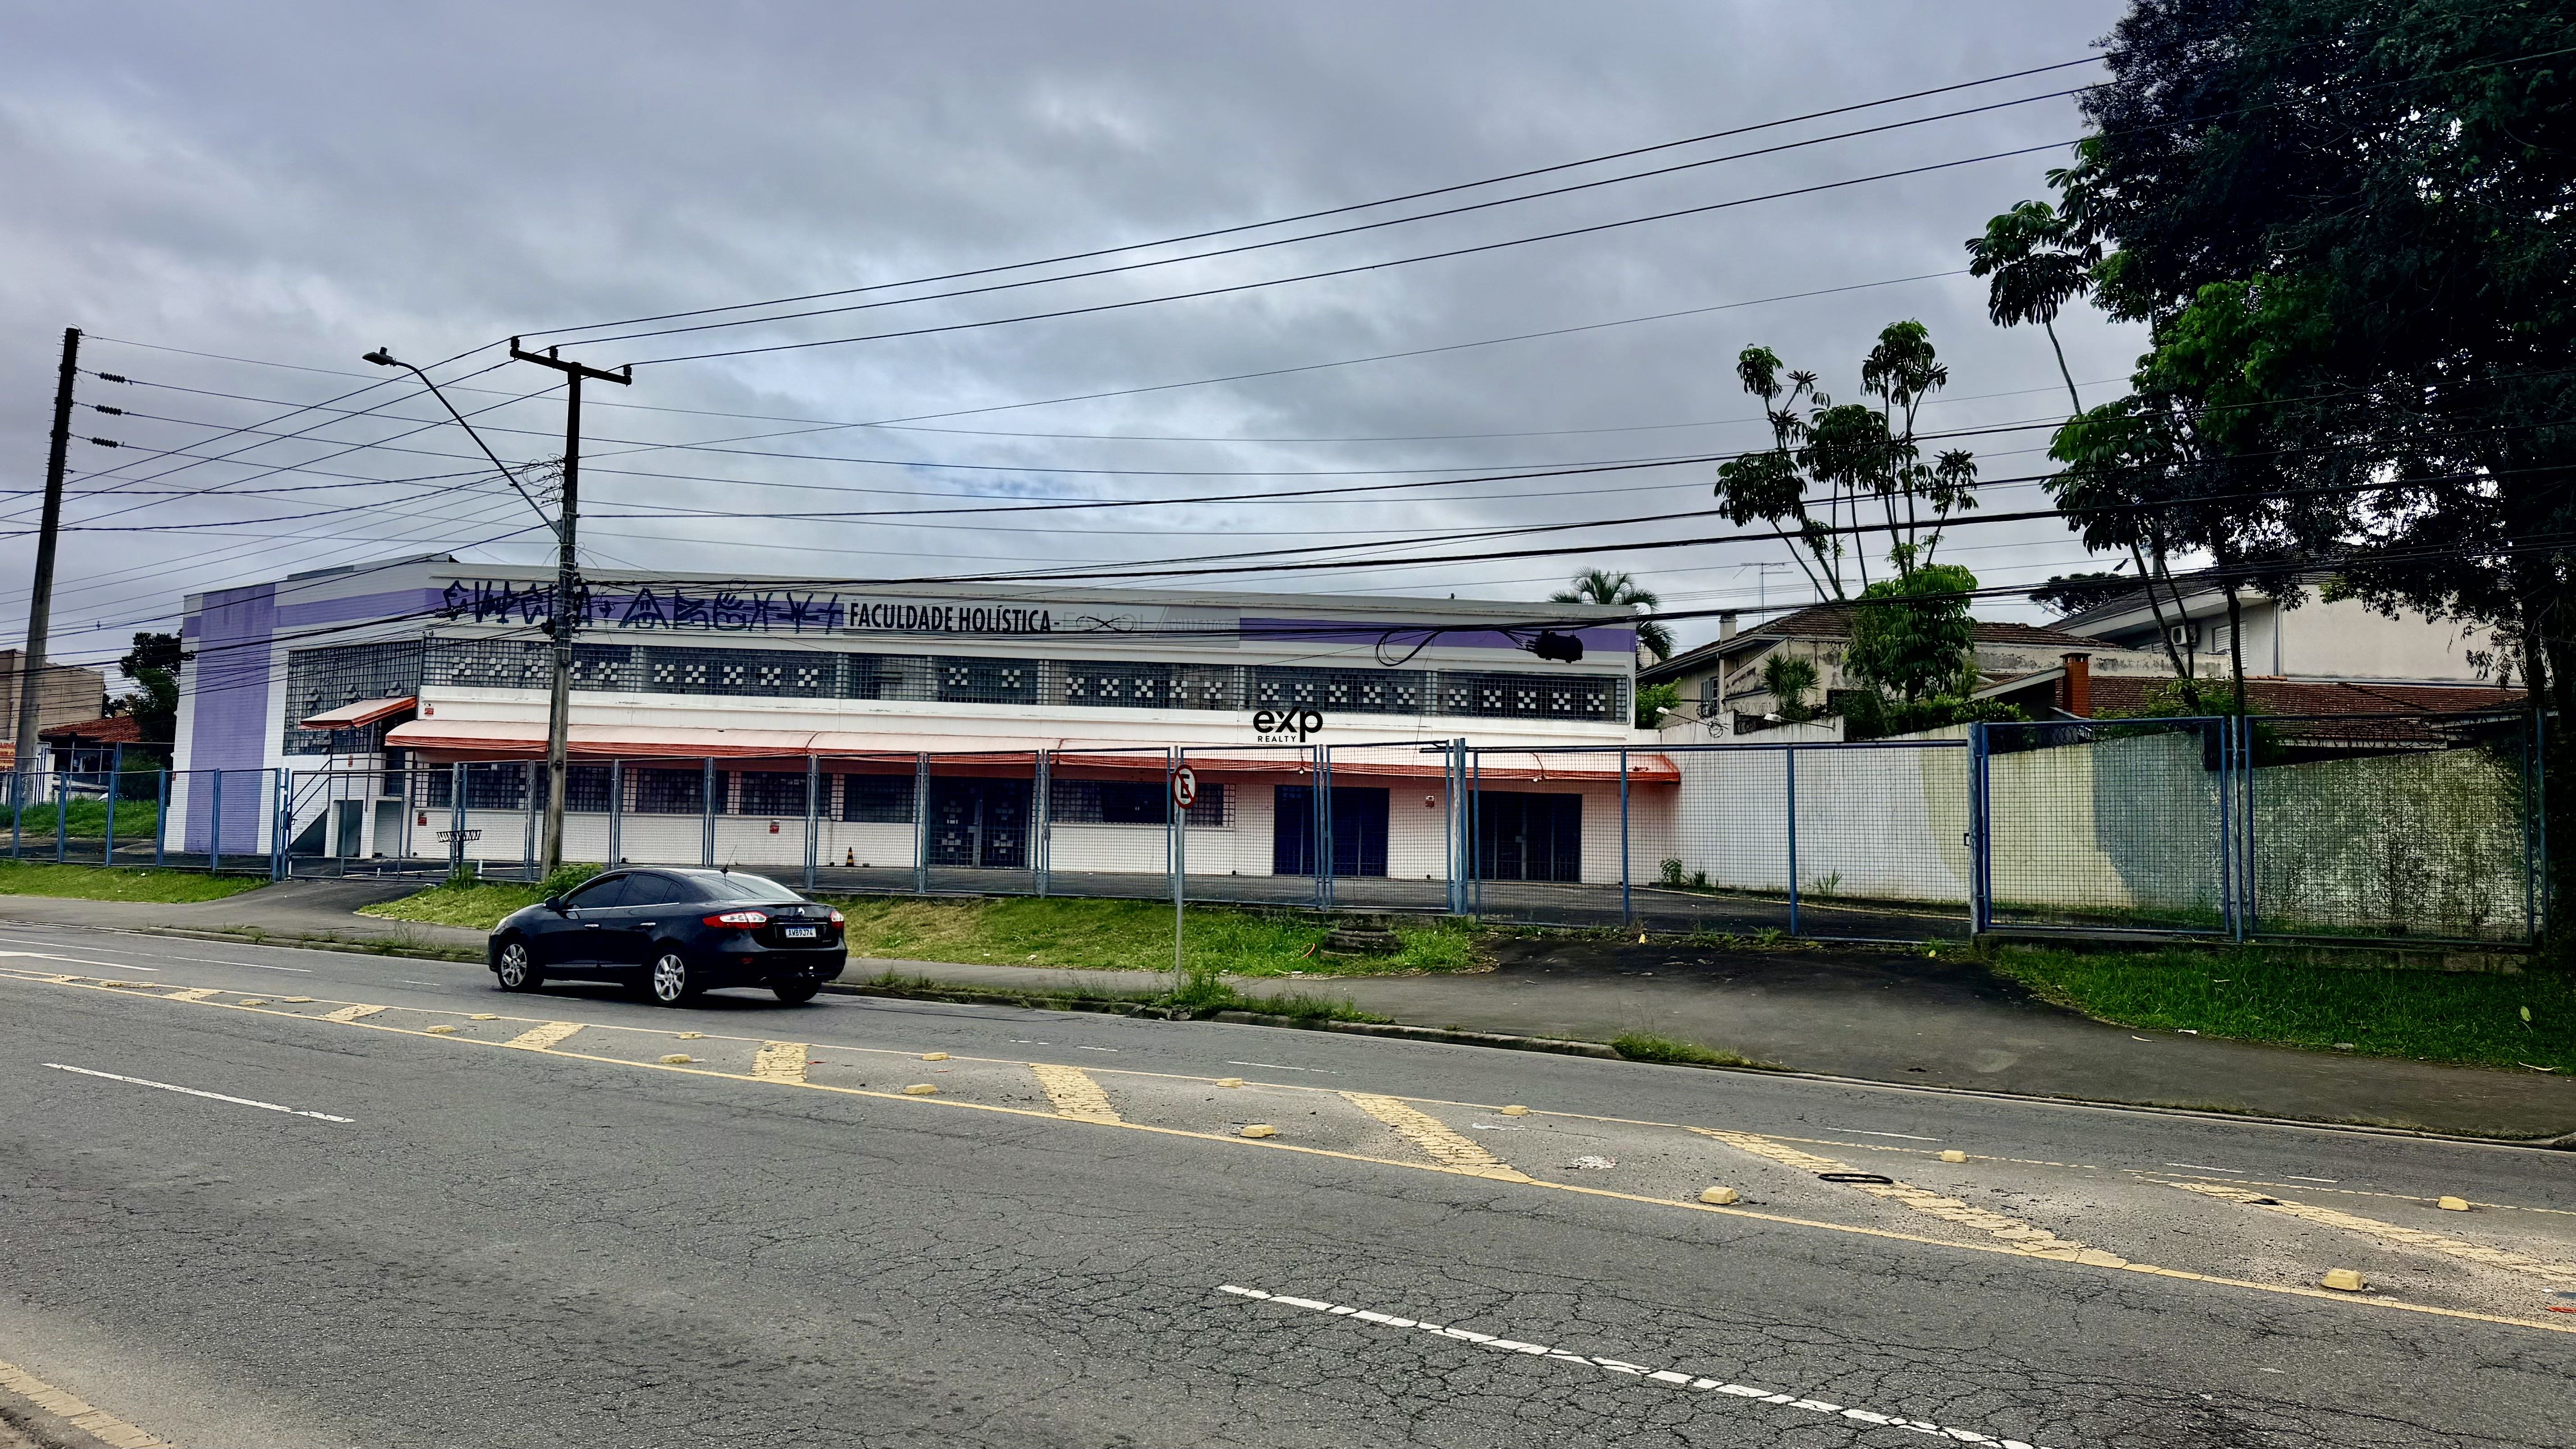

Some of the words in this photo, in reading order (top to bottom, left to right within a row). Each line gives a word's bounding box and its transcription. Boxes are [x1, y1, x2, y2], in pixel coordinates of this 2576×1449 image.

[850, 603, 953, 630] FACULDADE
[958, 605, 1051, 631] HOLÍSTICA
[1180, 773, 1190, 799] E
